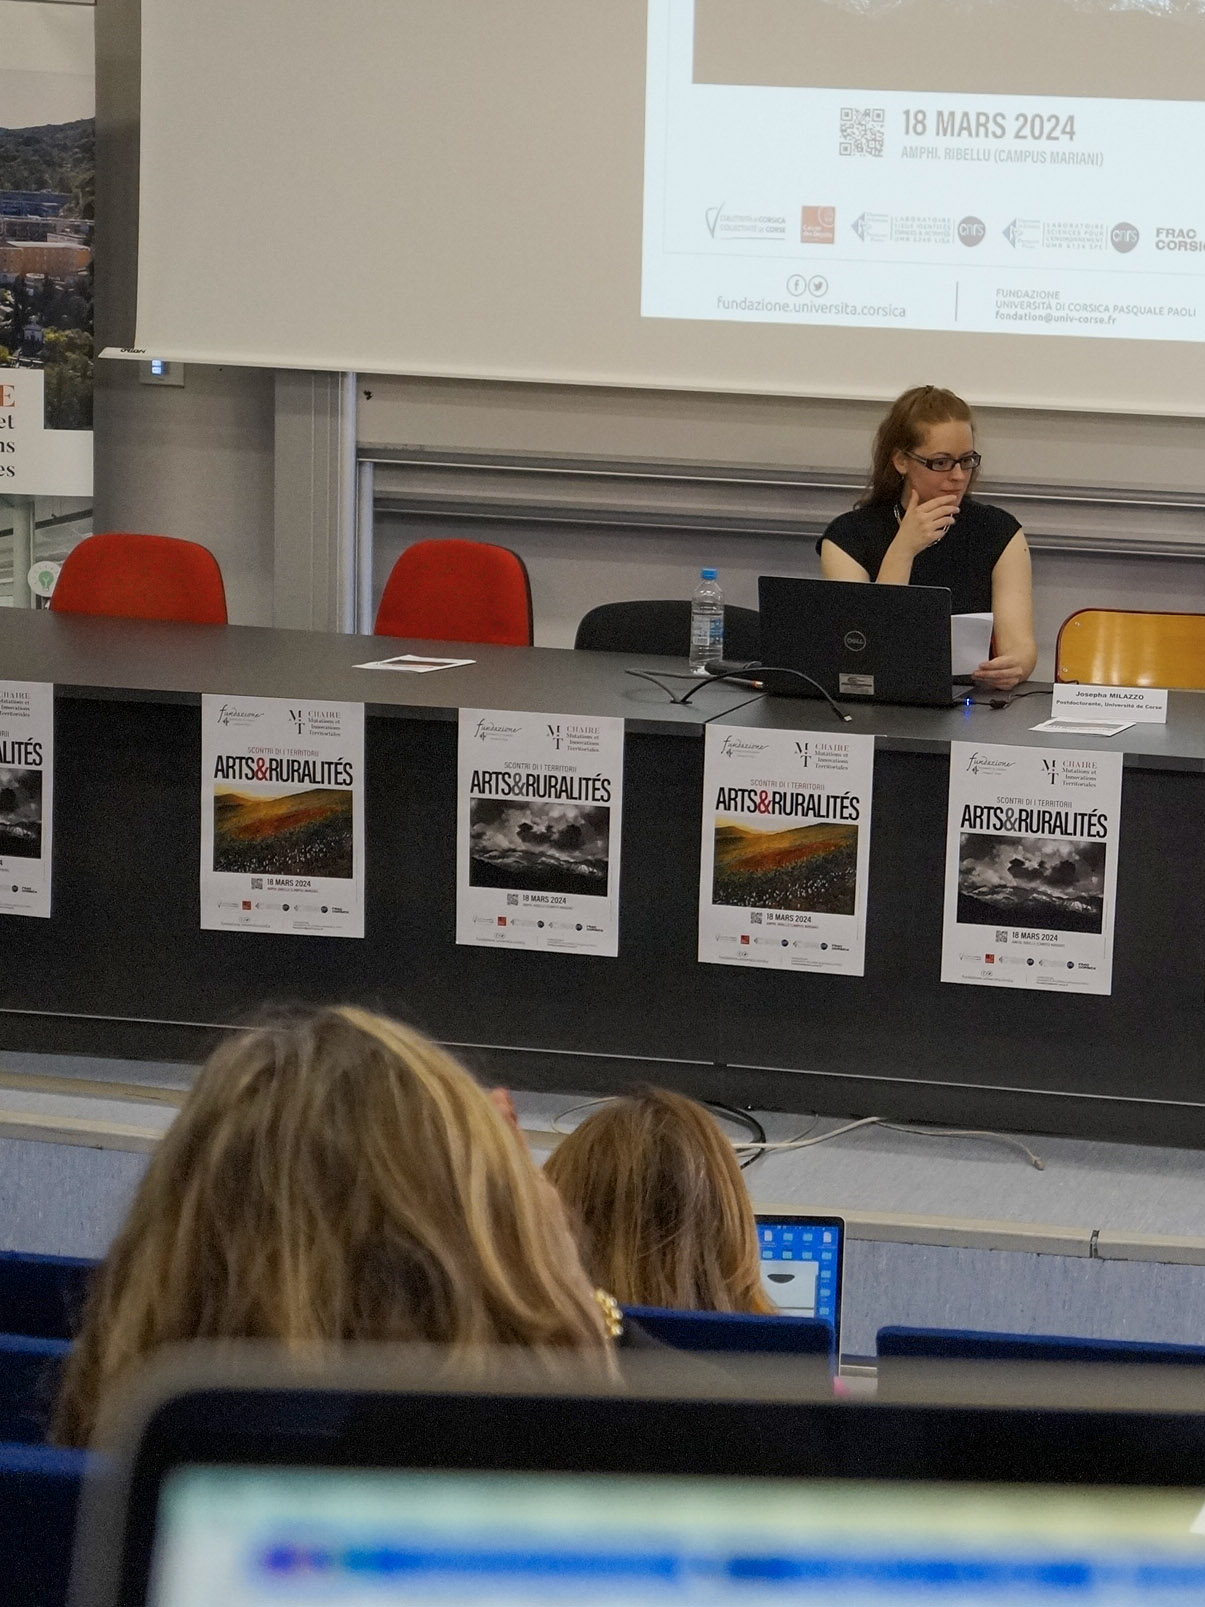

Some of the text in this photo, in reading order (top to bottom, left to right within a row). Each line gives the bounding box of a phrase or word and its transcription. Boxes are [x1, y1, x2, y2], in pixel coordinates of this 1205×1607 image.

[902, 109, 1076, 141] 18 MARS 2024
[901, 146, 1104, 167] AMPHI. RIBELLU (CAMPUS MARIANI)
[959, 224, 984, 236] cnrs
[1155, 227, 1197, 239] FRAC
[1112, 230, 1138, 242] cnrs
[996, 288, 1060, 299] FUNDAZIONE
[716, 296, 906, 318] fundazione.universita.corsica
[1055, 302, 1065, 311] DI
[1067, 302, 1110, 313] CORSICA
[1112, 304, 1165, 316] PASQUALE
[1167, 307, 1197, 317] PAOLI
[995, 310, 1117, 325] fondation@univ-corse.fr
[1075, 691, 1145, 701] Josepha MILAZZO
[750, 779, 777, 787] SCONTRI
[779, 780, 786, 788] DI
[996, 796, 1024, 805] SCONTRI
[1025, 797, 1032, 805] DI
[275, 878, 294, 887] MARS
[295, 879, 311, 887] 2024
[530, 895, 549, 903] MARS
[550, 896, 567, 904] 2024
[775, 913, 793, 922] MARS
[795, 914, 812, 923] 2024
[1020, 932, 1039, 941] MARS
[1041, 933, 1058, 942] 2024
